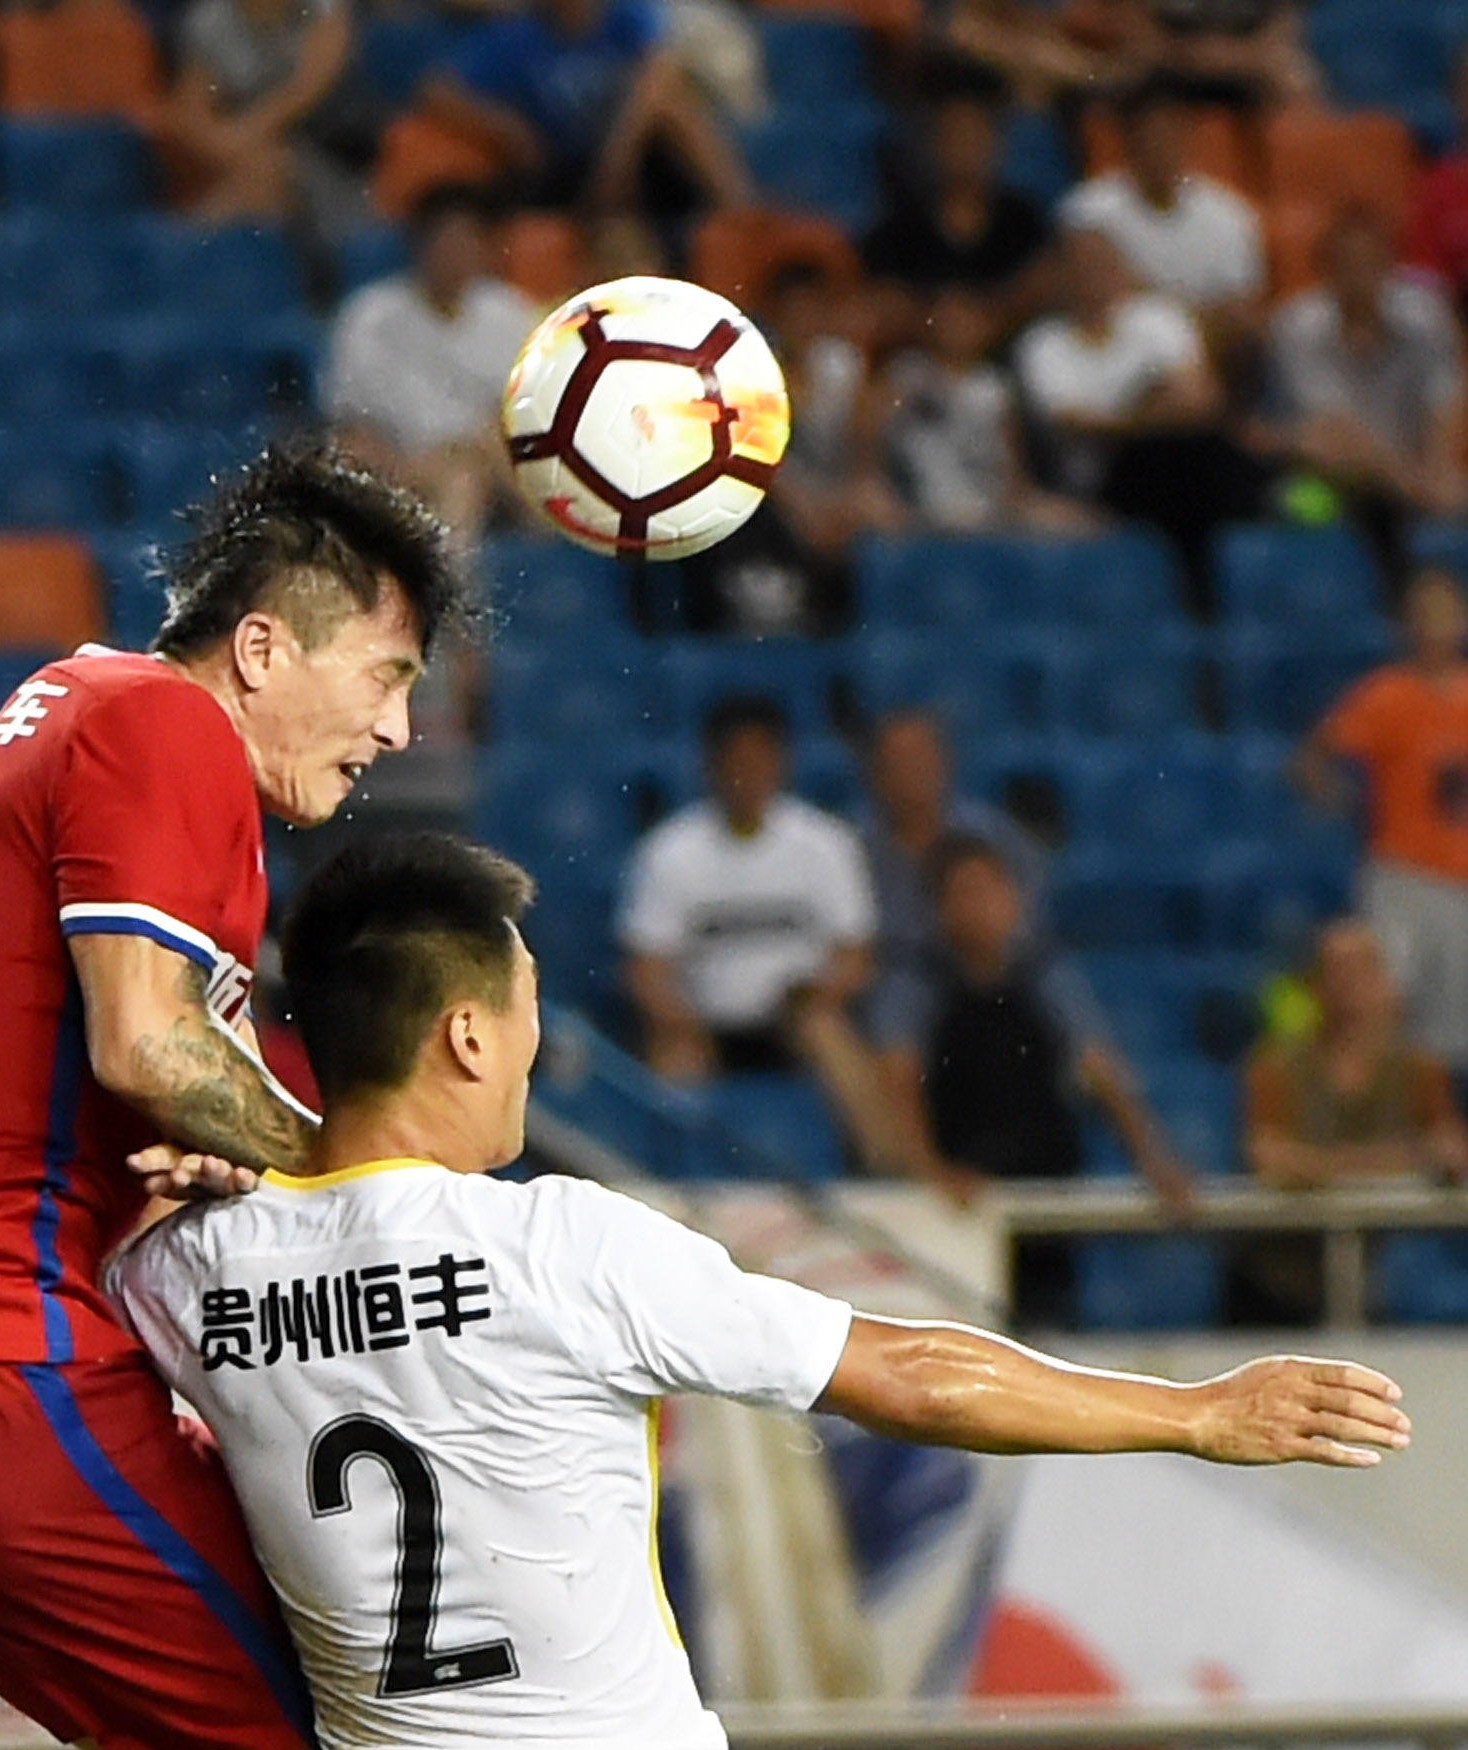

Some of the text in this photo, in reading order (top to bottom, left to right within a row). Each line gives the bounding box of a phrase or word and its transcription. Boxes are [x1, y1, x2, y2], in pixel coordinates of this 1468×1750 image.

[200, 1253, 492, 1372] 贵州恒丰
[307, 1412, 520, 1699] 2
